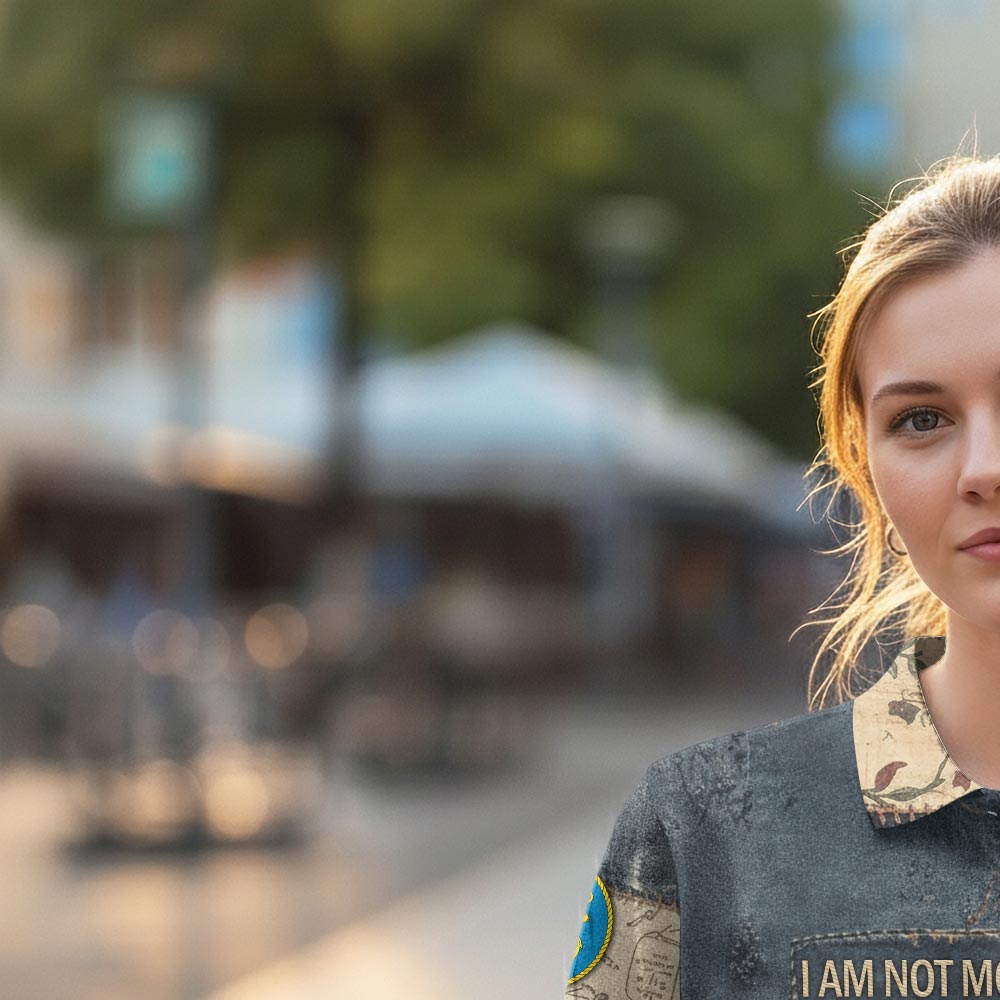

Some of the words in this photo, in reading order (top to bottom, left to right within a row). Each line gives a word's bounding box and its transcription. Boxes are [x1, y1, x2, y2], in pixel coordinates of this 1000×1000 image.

[802, 960, 809, 997] I
[819, 960, 873, 997] AM
[885, 959, 954, 997] NOT
